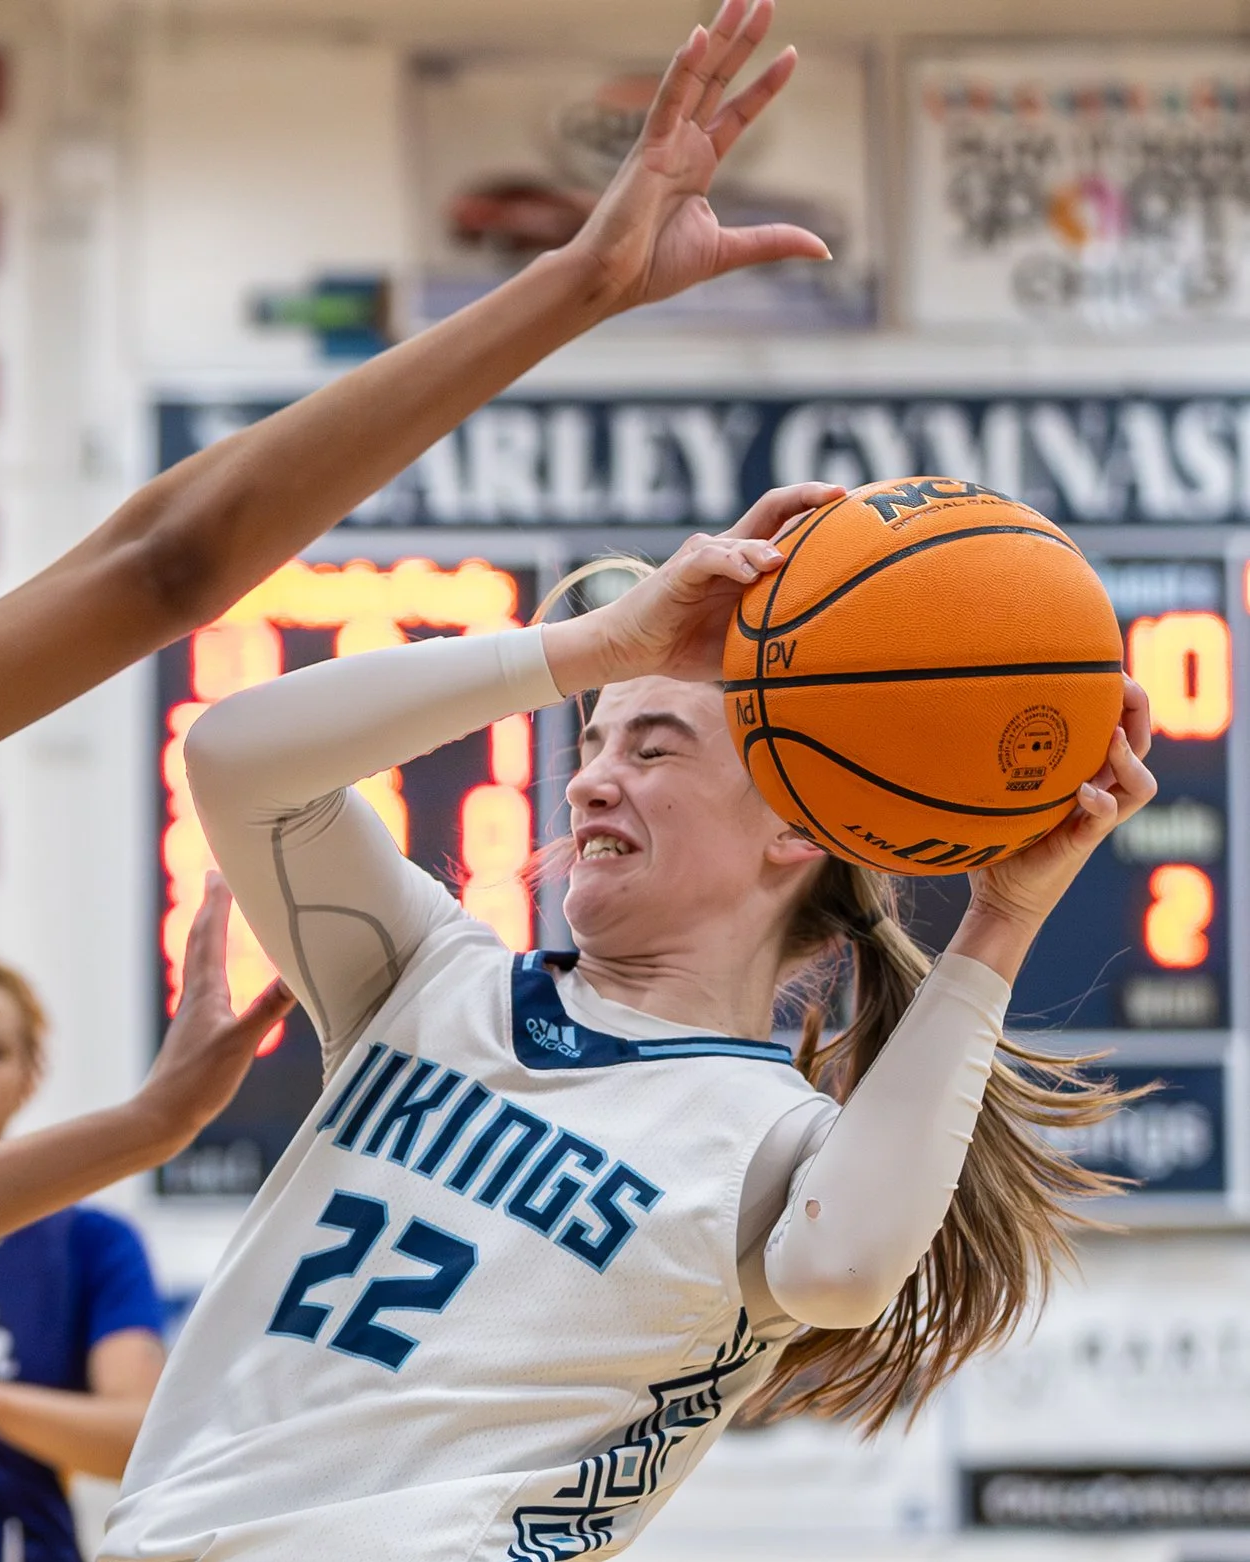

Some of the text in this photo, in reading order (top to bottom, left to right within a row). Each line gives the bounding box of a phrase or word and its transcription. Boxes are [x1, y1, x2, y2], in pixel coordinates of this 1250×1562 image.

[350, 402, 763, 520] ARLEY
[525, 1017, 582, 1058] adidas
[265, 1188, 479, 1374] 22
